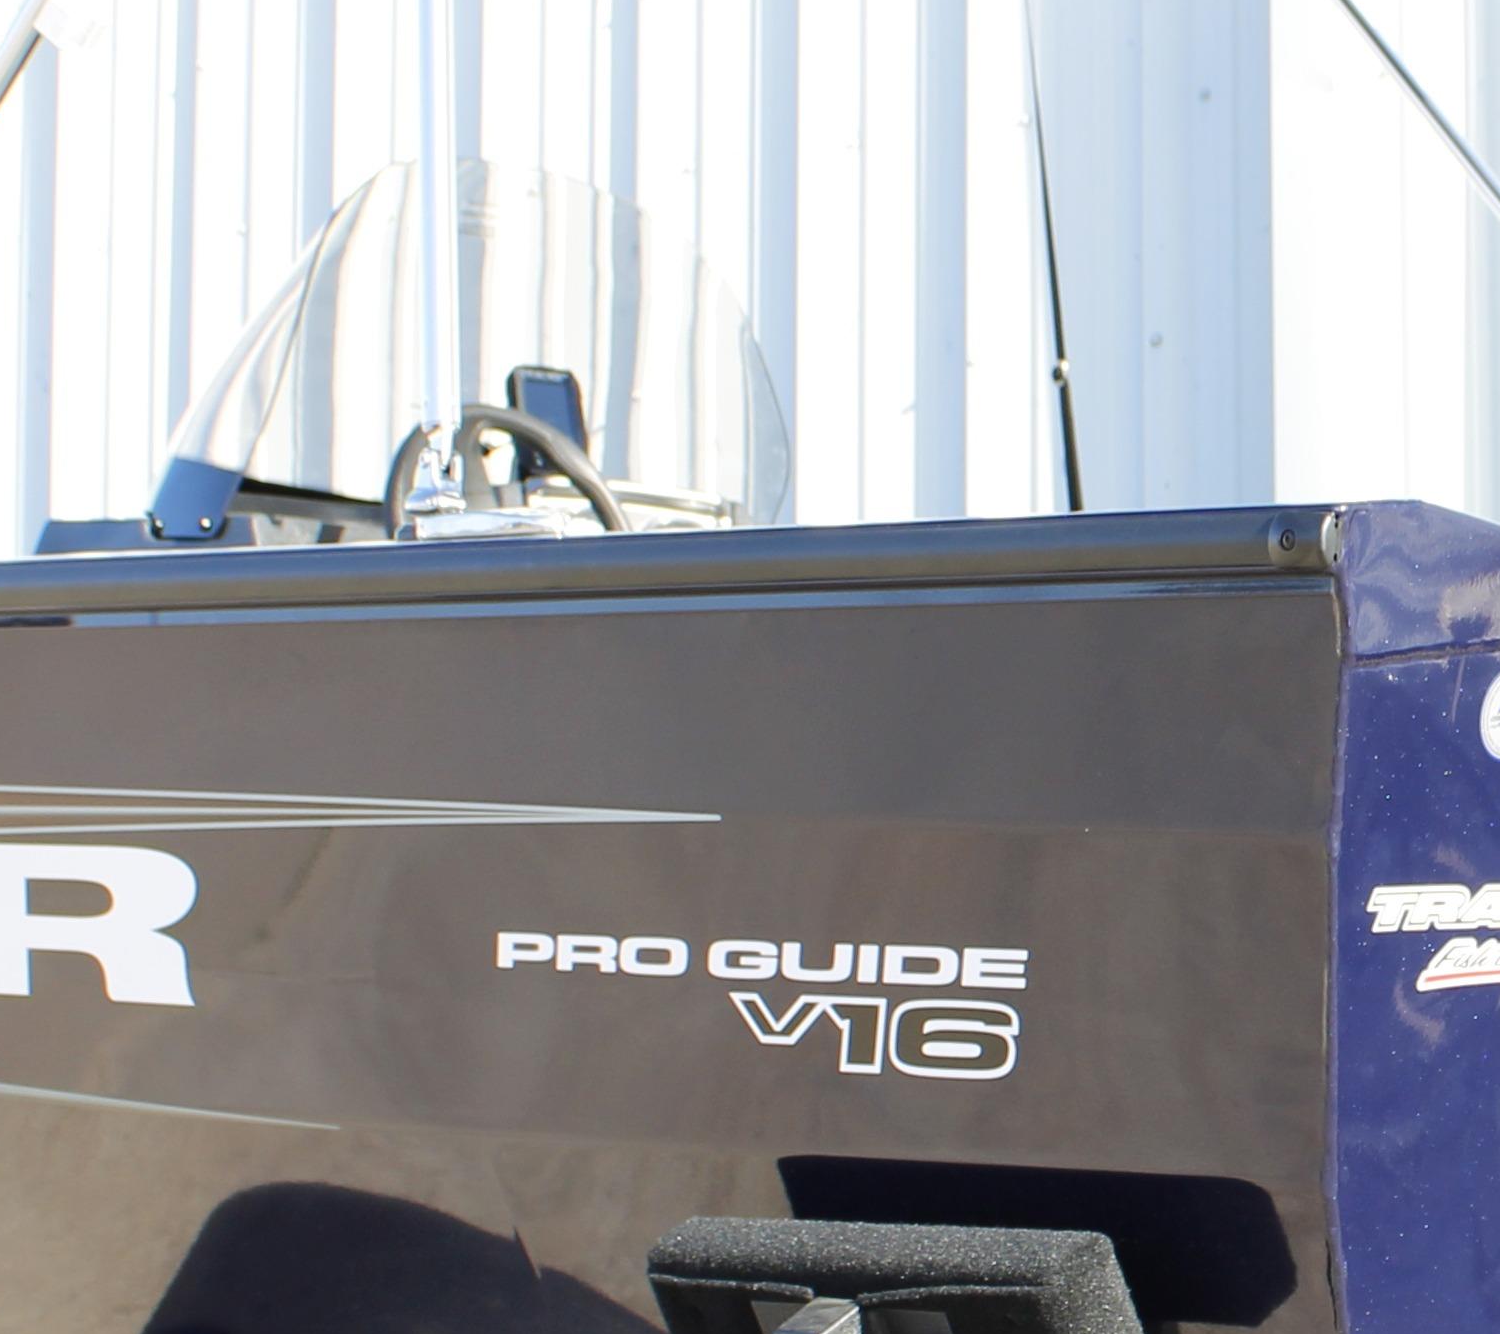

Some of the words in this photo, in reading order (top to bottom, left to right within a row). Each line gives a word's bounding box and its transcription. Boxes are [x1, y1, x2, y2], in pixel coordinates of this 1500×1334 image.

[496, 931, 689, 977] PRO
[707, 938, 1029, 989] GUIDE
[1435, 940, 1490, 971] Fish
[729, 991, 1021, 1080] V16
